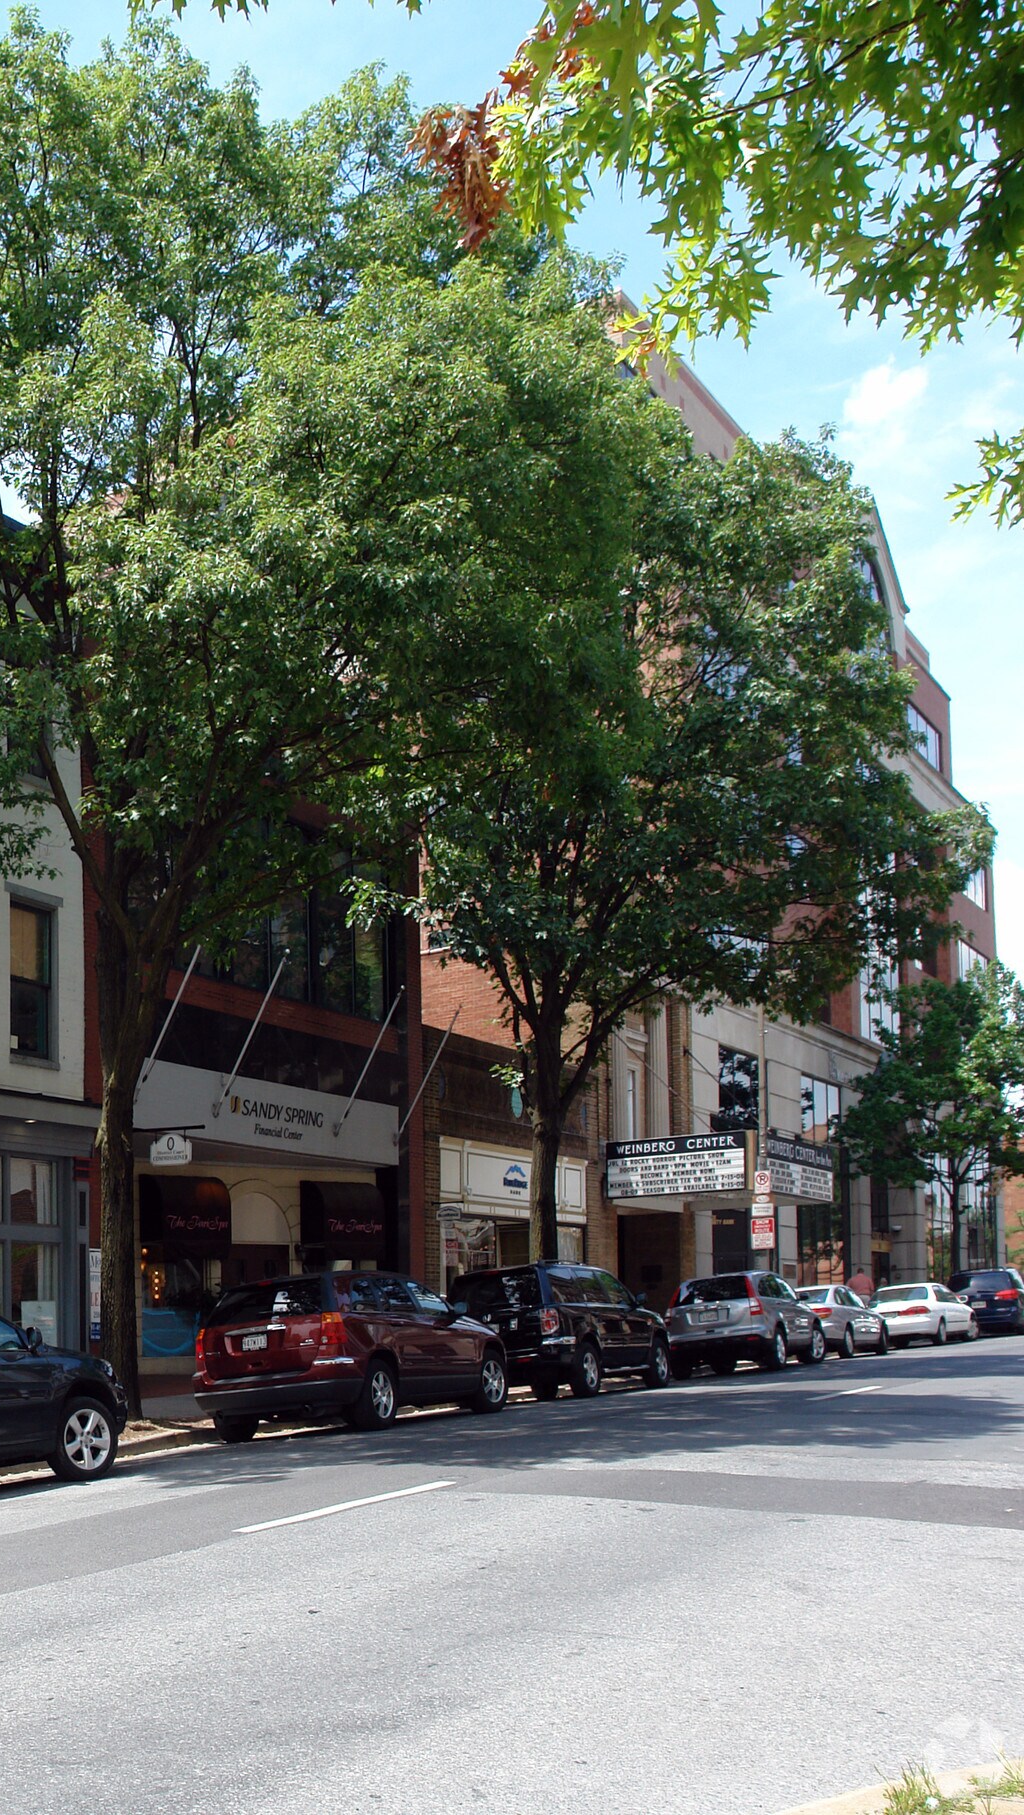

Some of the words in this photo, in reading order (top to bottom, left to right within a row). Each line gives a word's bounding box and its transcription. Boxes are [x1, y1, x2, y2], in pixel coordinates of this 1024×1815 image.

[241, 1099, 284, 1120] SANDY
[284, 1107, 324, 1128] SPRING
[254, 1123, 283, 1138] Financial
[283, 1127, 303, 1140] Center
[616, 1141, 676, 1155] WEINBERG
[686, 1135, 738, 1149] CENTER
[629, 1158, 650, 1166] ROCKY
[652, 1155, 676, 1164] HORROR
[678, 1153, 705, 1161] PICTURE
[795, 1145, 816, 1166] CENTER
[653, 1164, 670, 1172] BAND
[609, 1181, 633, 1189] MEMBER
[641, 1178, 678, 1187] SUBSCRIBER
[640, 1172, 663, 1180] BECOME
[642, 1186, 665, 1194] SEASON
[683, 1182, 716, 1191] AVAILABLE
[167, 1214, 186, 1229] The
[328, 1218, 345, 1233] The
